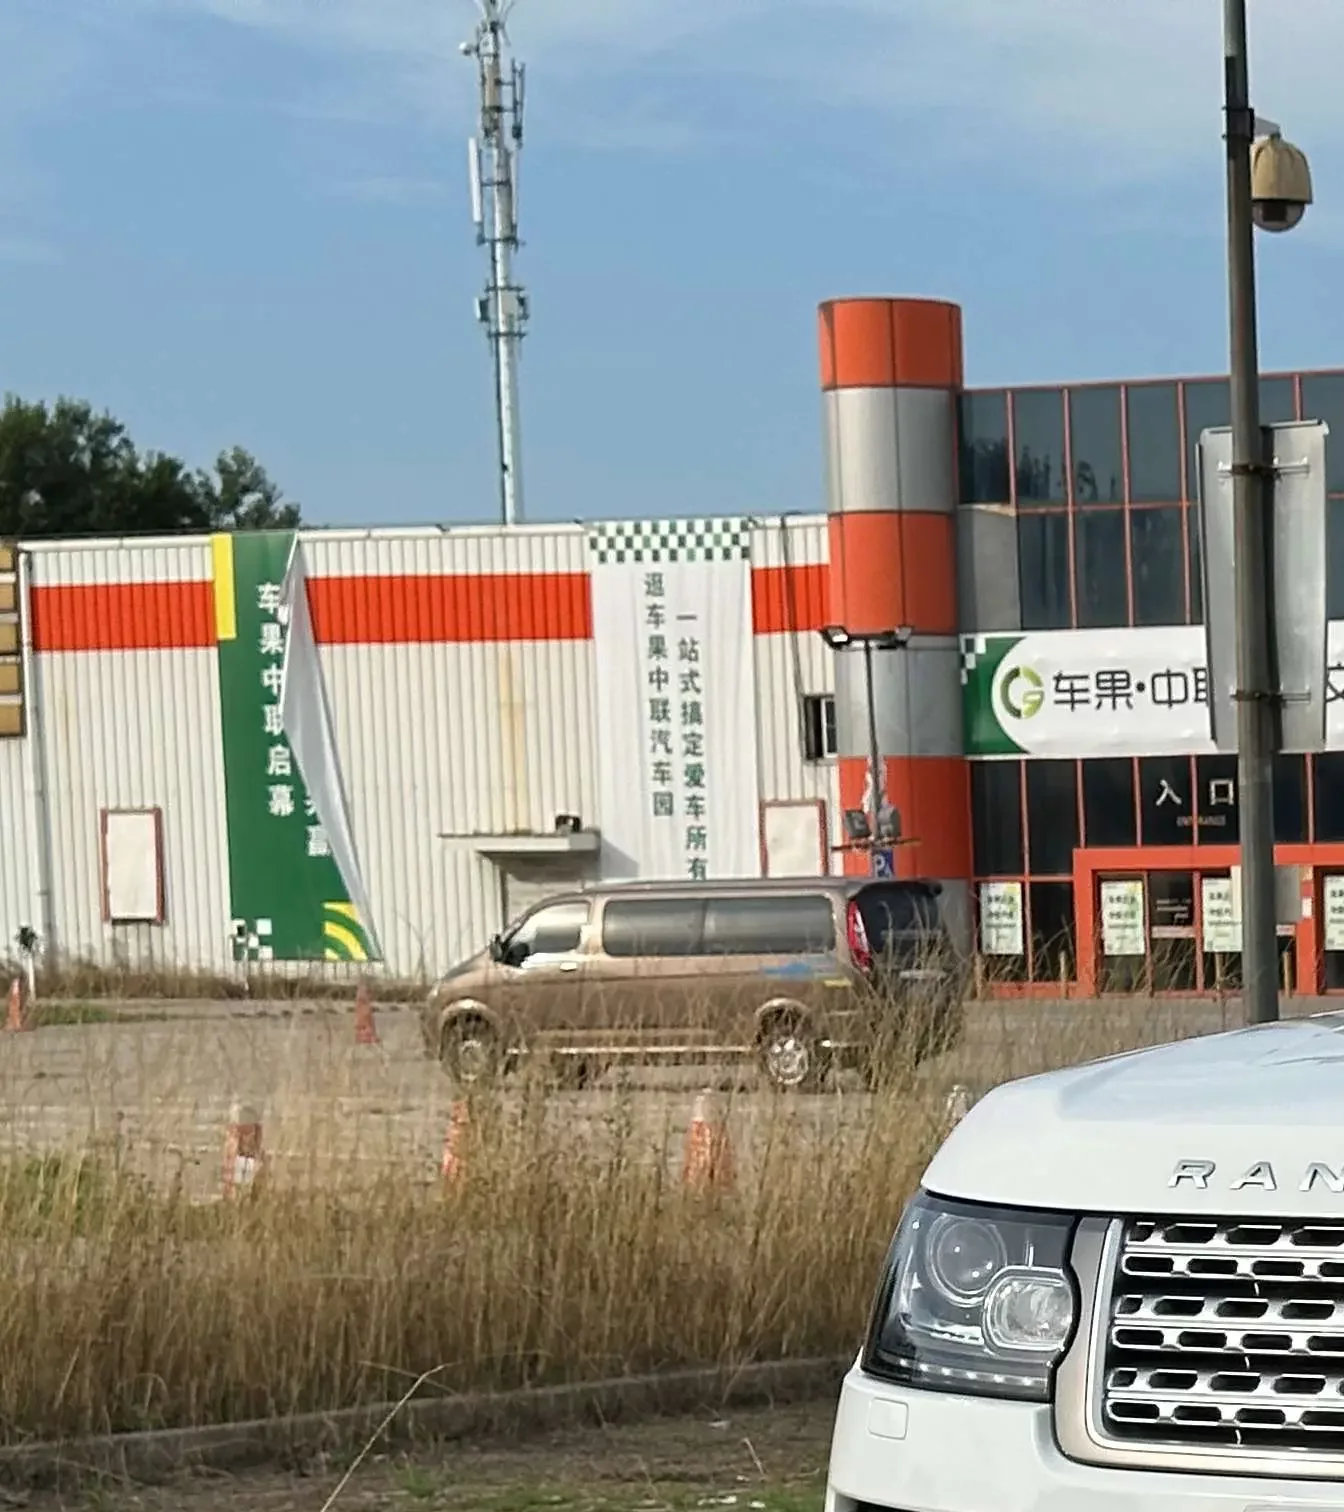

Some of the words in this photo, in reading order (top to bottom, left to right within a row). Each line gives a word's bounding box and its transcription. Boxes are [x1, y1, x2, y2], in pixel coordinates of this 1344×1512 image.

[645, 572, 674, 817] 逛车果中联汽车园
[676, 613, 708, 881] 一站式搞定爱车所有
[1155, 779, 1234, 806] 入口
